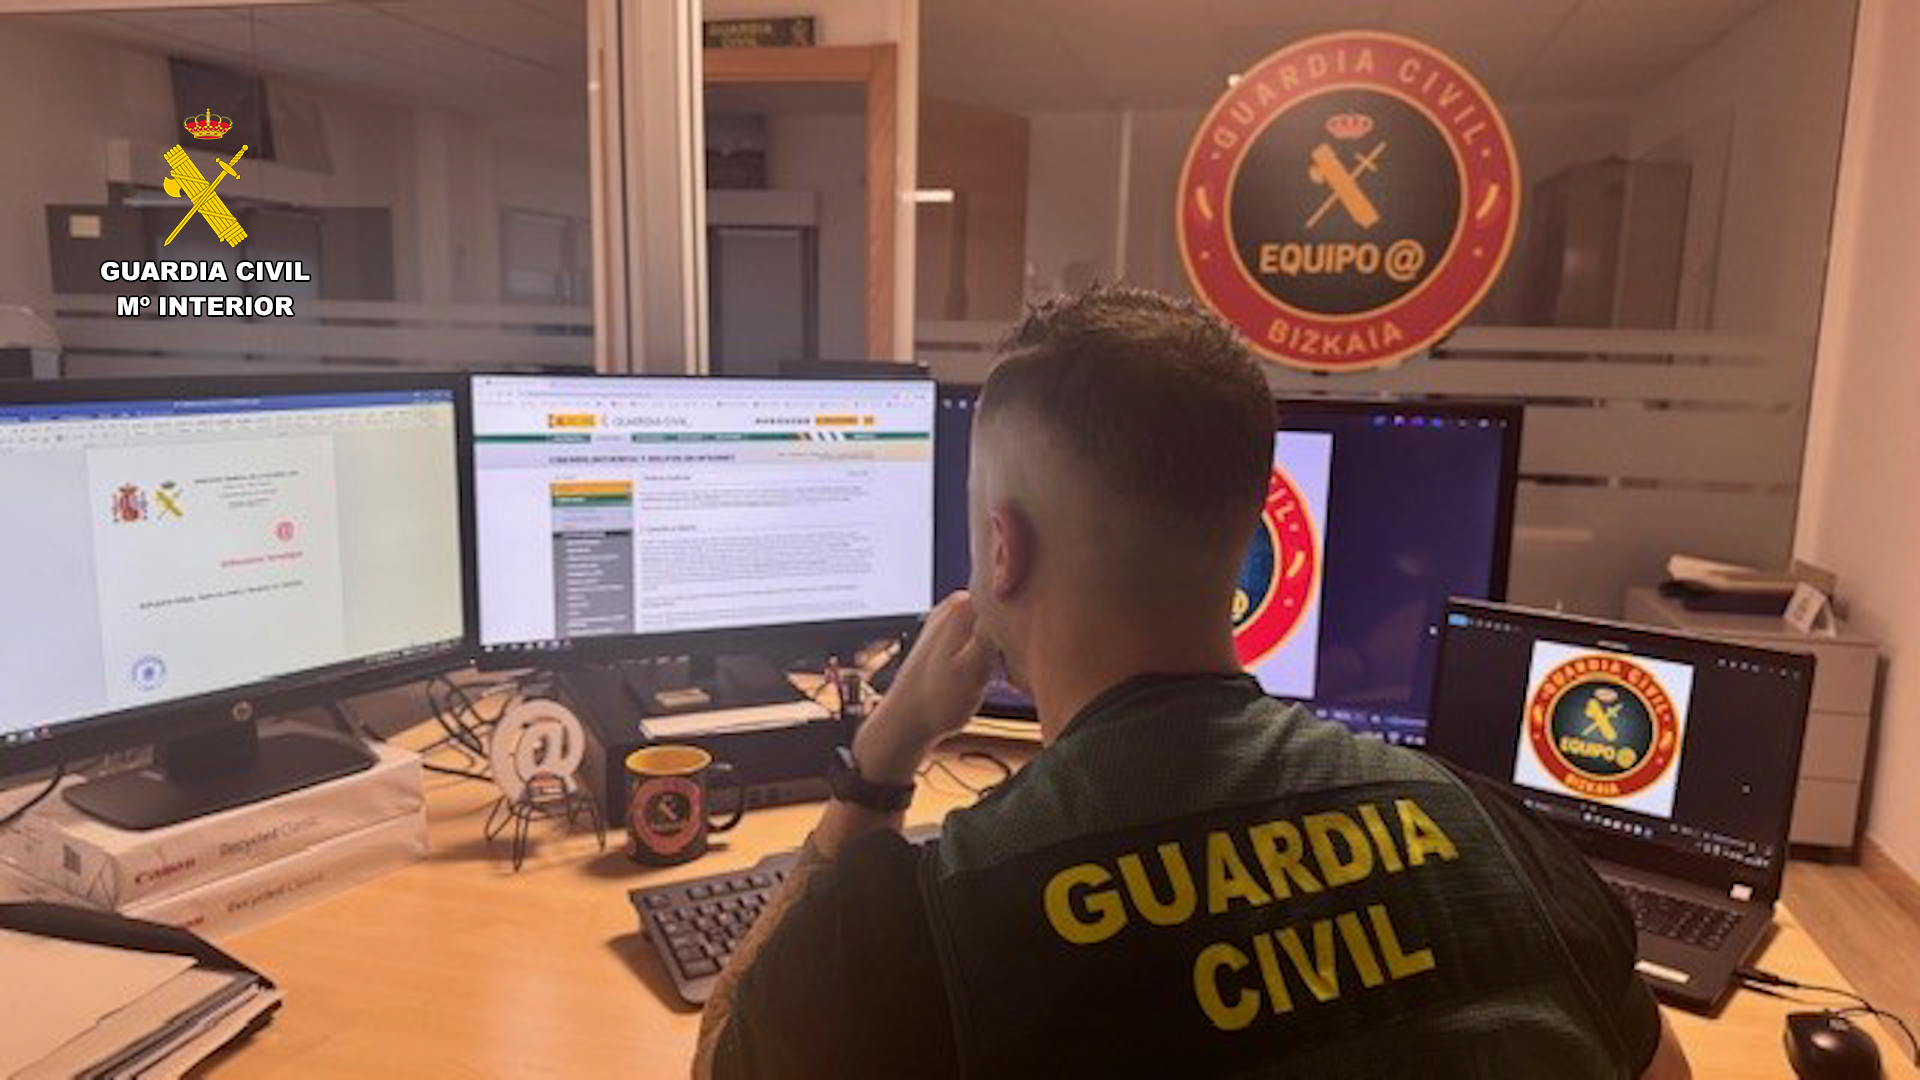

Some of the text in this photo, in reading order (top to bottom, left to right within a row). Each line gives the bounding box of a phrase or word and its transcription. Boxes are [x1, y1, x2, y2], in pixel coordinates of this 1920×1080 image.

[1213, 49, 1487, 149] GUARDIA CIVIL
[1259, 238, 1425, 281] EQUIPO @
[1268, 318, 1404, 355] BIZKAIA
[1540, 658, 1670, 716] GUARDIA CIVIL
[1559, 735, 1616, 762] EQUIPO
[1043, 796, 1459, 945] GUARDIA
[1192, 904, 1436, 1031] CIVIL
